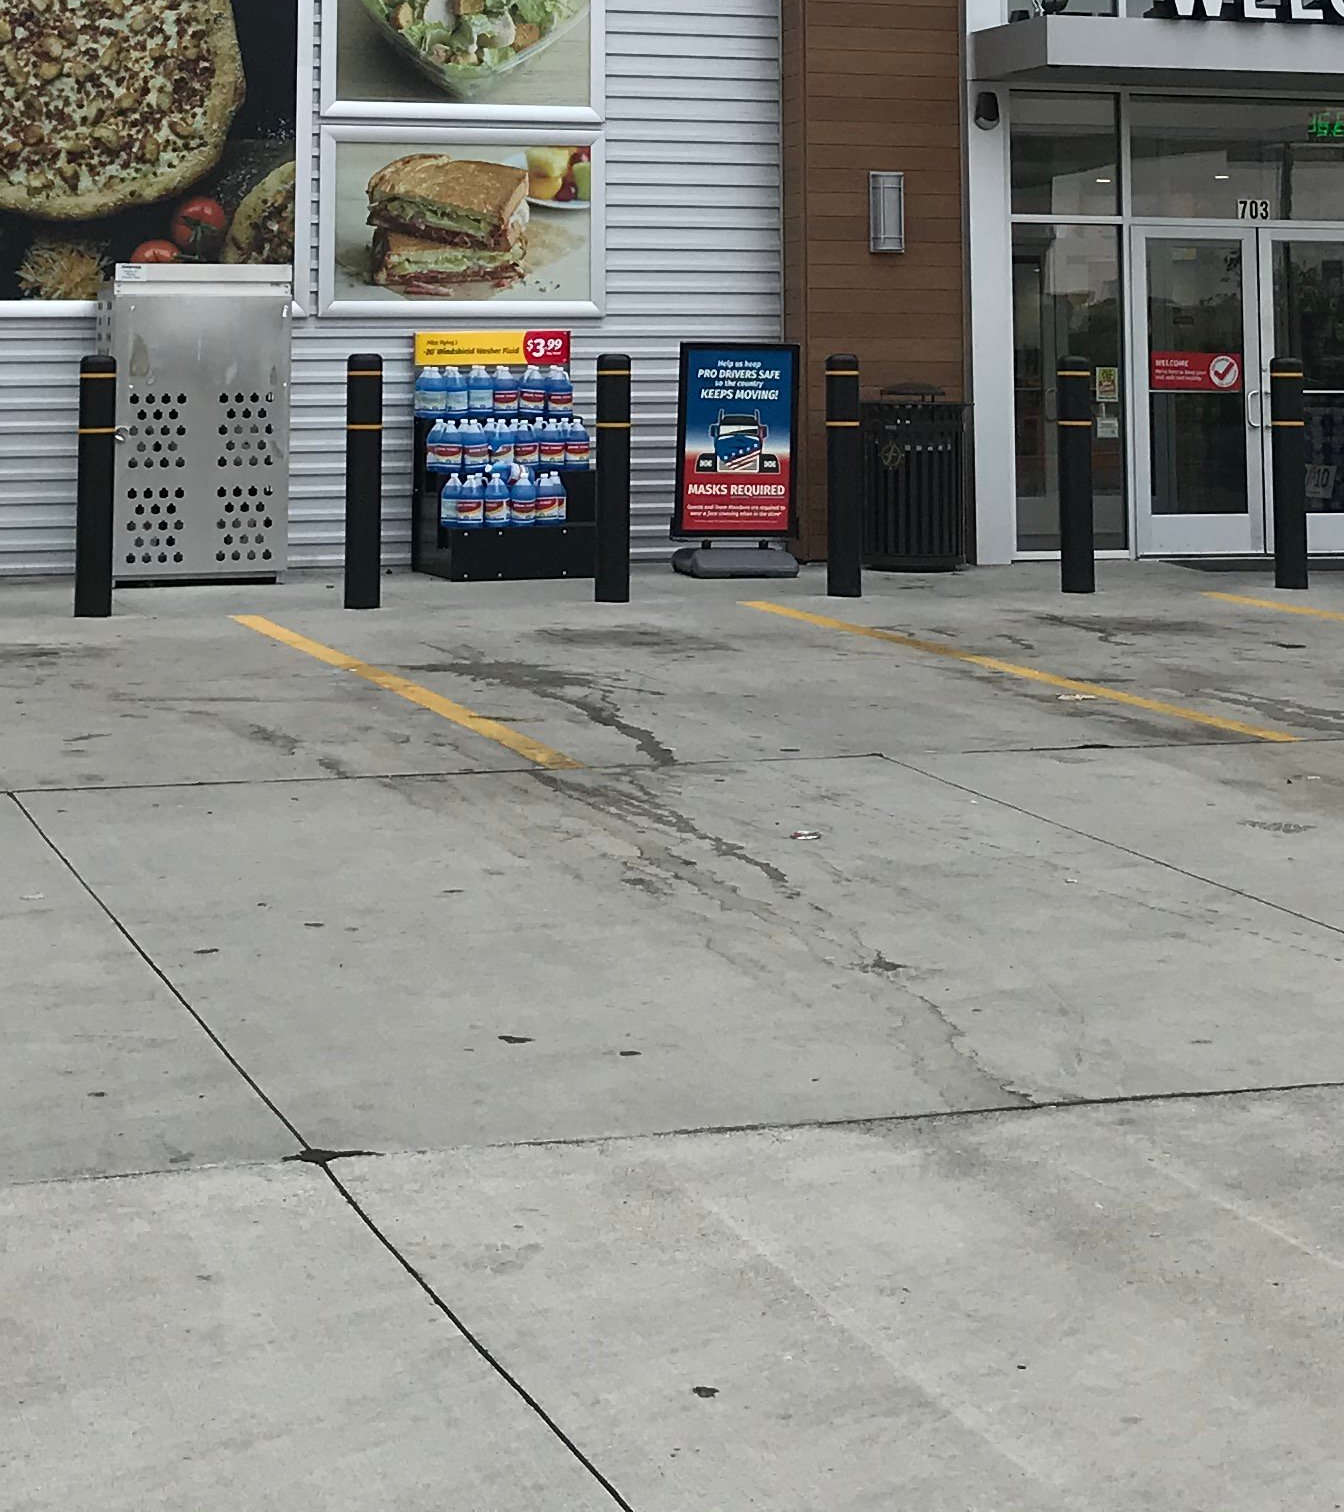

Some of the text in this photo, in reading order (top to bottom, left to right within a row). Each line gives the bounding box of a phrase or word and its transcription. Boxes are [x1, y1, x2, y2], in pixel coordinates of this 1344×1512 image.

[1239, 200, 1269, 220] 703
[526, 338, 563, 358] $3.99
[717, 359, 733, 368] Help
[745, 360, 762, 369] keep
[697, 369, 781, 379] PRO DRIVERS SAFE
[737, 381, 764, 389] country
[700, 389, 779, 400] KEEPS MOVING!
[688, 484, 786, 496] MASKS REQUIRED
